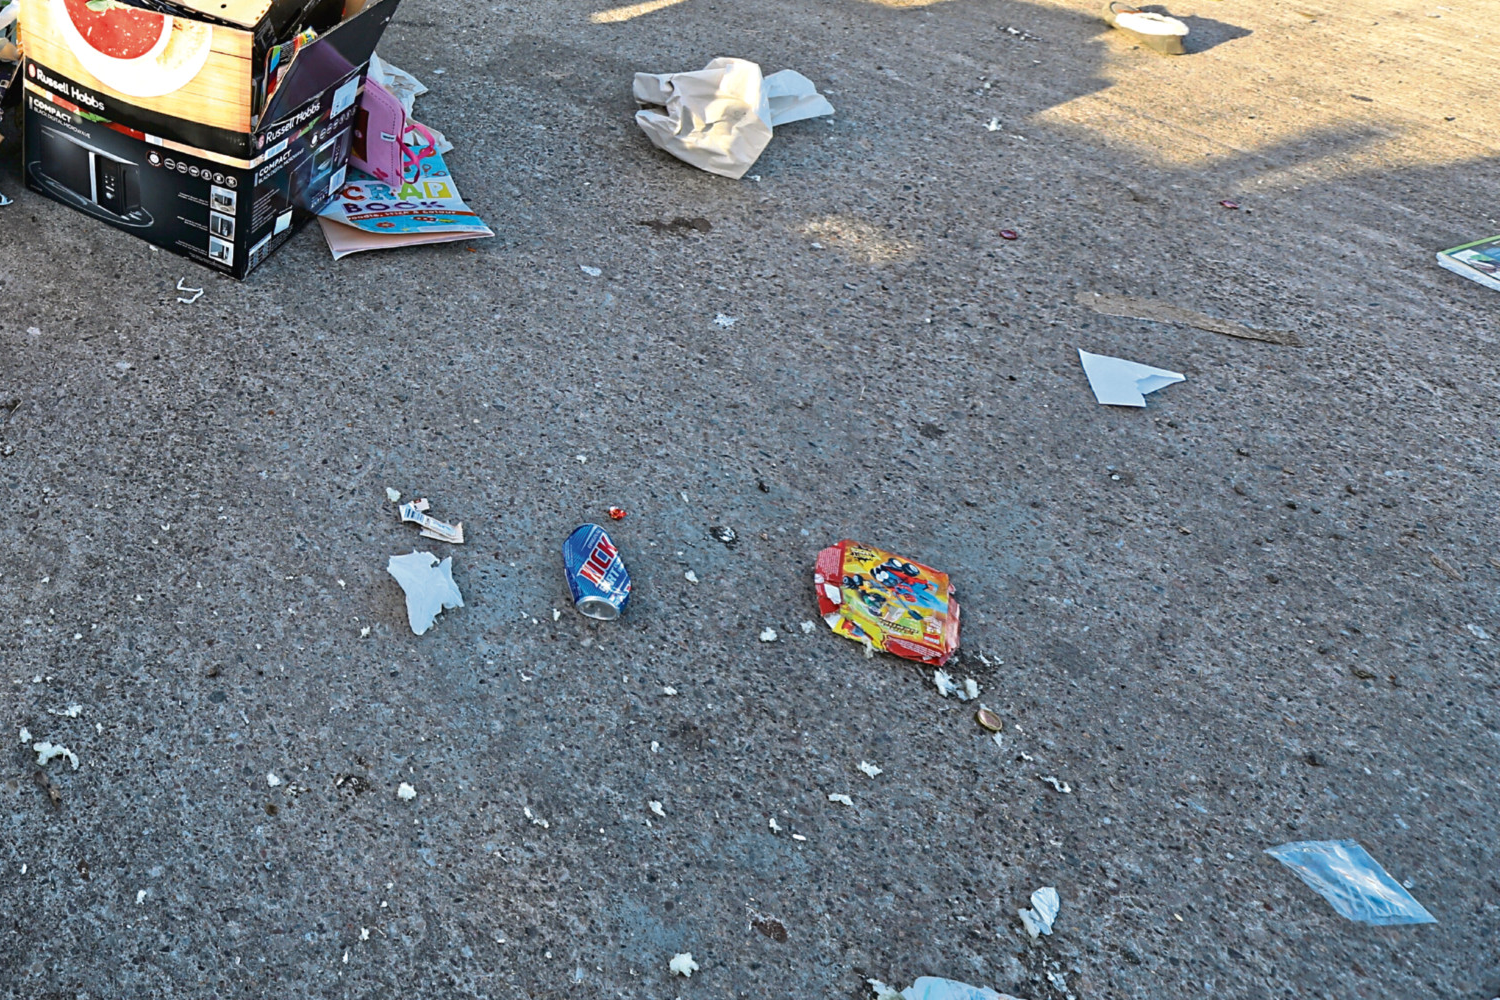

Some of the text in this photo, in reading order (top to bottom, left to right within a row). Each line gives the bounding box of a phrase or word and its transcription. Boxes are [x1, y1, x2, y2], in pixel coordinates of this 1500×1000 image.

[36, 68, 105, 111] Russell Hobbs
[33, 99, 71, 122] COMPACT
[266, 101, 321, 144] Russell Hobbs
[258, 149, 292, 177] COMPACT
[342, 181, 453, 201] CRAP
[341, 201, 446, 214] BOOK
